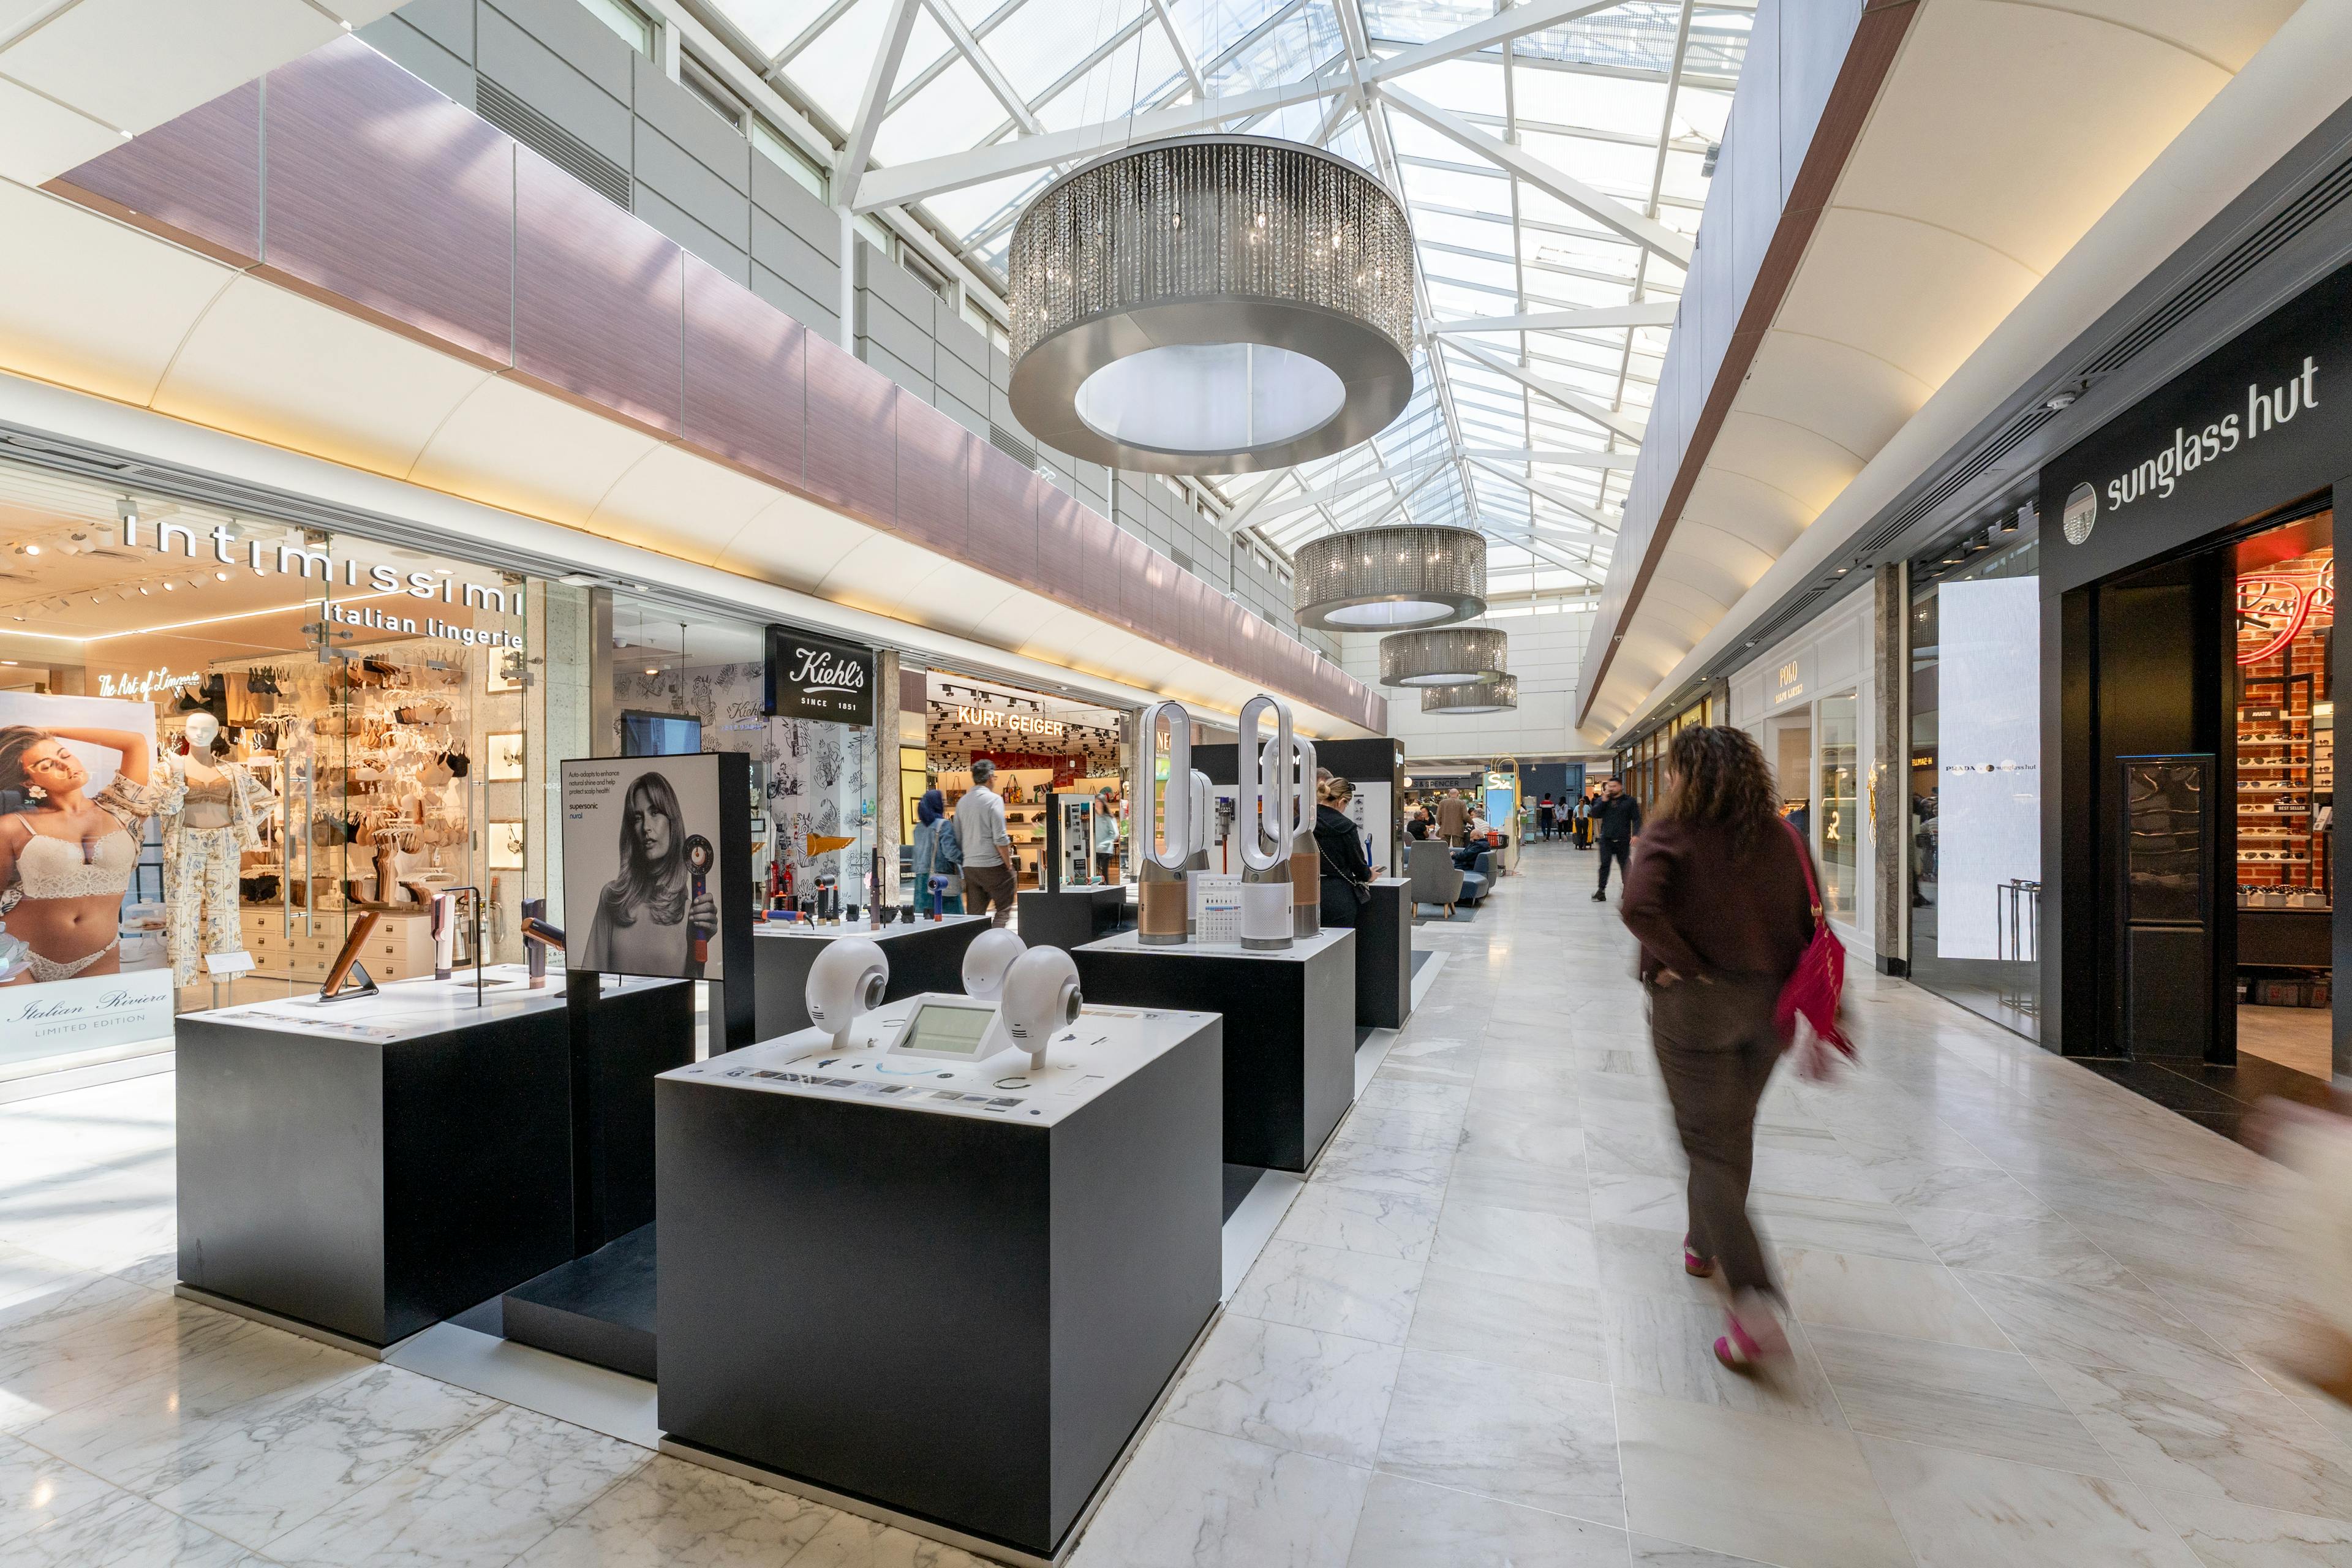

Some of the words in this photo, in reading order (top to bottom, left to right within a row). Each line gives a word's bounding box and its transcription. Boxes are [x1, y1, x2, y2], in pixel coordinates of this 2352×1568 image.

[2108, 413, 2239, 511] sunglass
[2248, 356, 2319, 439] hut
[124, 515, 522, 615] intimissimi
[322, 601, 416, 633] Italian
[426, 618, 523, 648] lingerie
[790, 648, 864, 687] Kiehl's
[1779, 661, 1798, 688] POLO
[99, 674, 116, 696] The
[118, 673, 138, 695] Art
[140, 671, 154, 701] of
[801, 698, 827, 707] SINCE
[958, 706, 1005, 728] KURT
[1009, 715, 1063, 736] GEIGER
[1157, 731, 1171, 750] NE
[569, 802, 598, 811] supersonic
[7, 999, 85, 1022] Italian
[96, 989, 167, 1009] Riviera
[35, 1023, 86, 1037] LIMITED
[94, 1014, 145, 1028] EDITION
